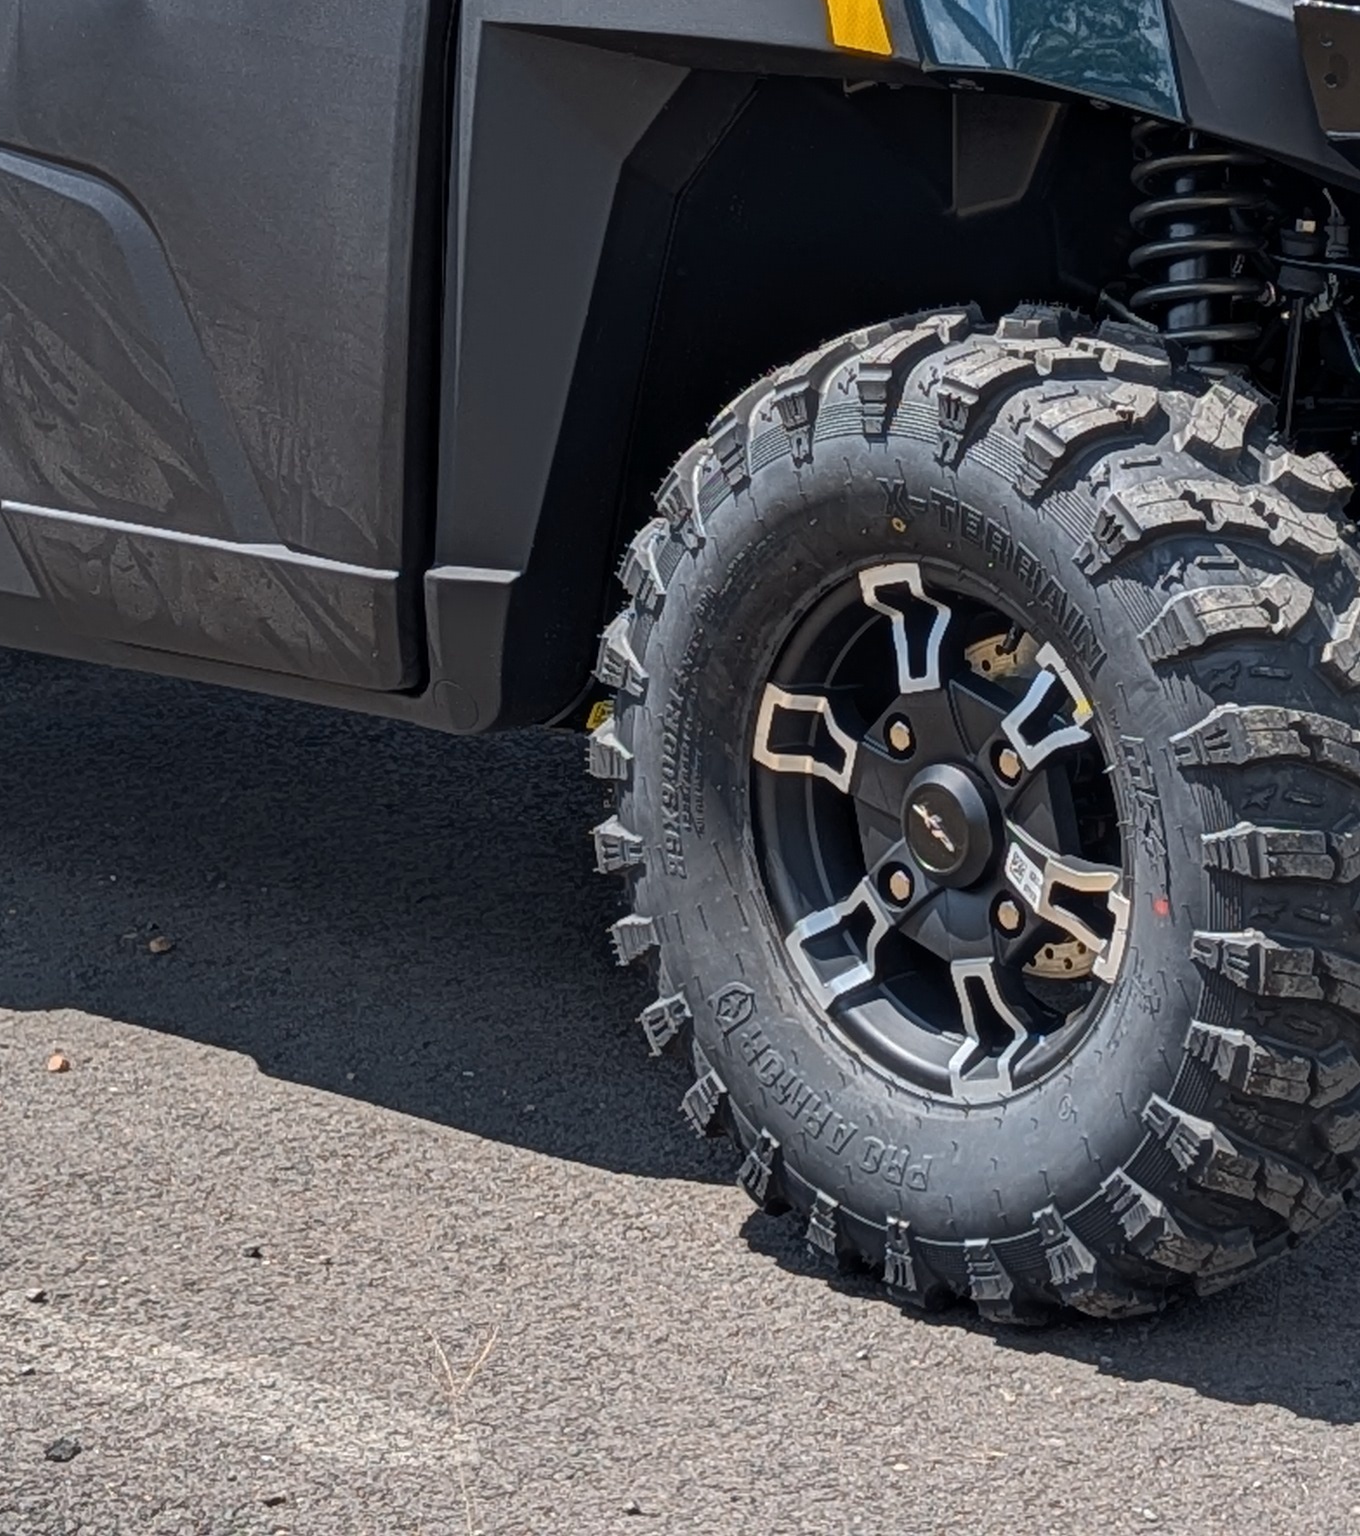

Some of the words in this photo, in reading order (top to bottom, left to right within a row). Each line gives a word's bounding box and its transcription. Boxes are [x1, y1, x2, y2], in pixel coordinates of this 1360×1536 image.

[875, 476, 1109, 681] X-TERRAIN
[739, 1021, 859, 1157] ARMOR
[857, 1134, 933, 1193] PRO
